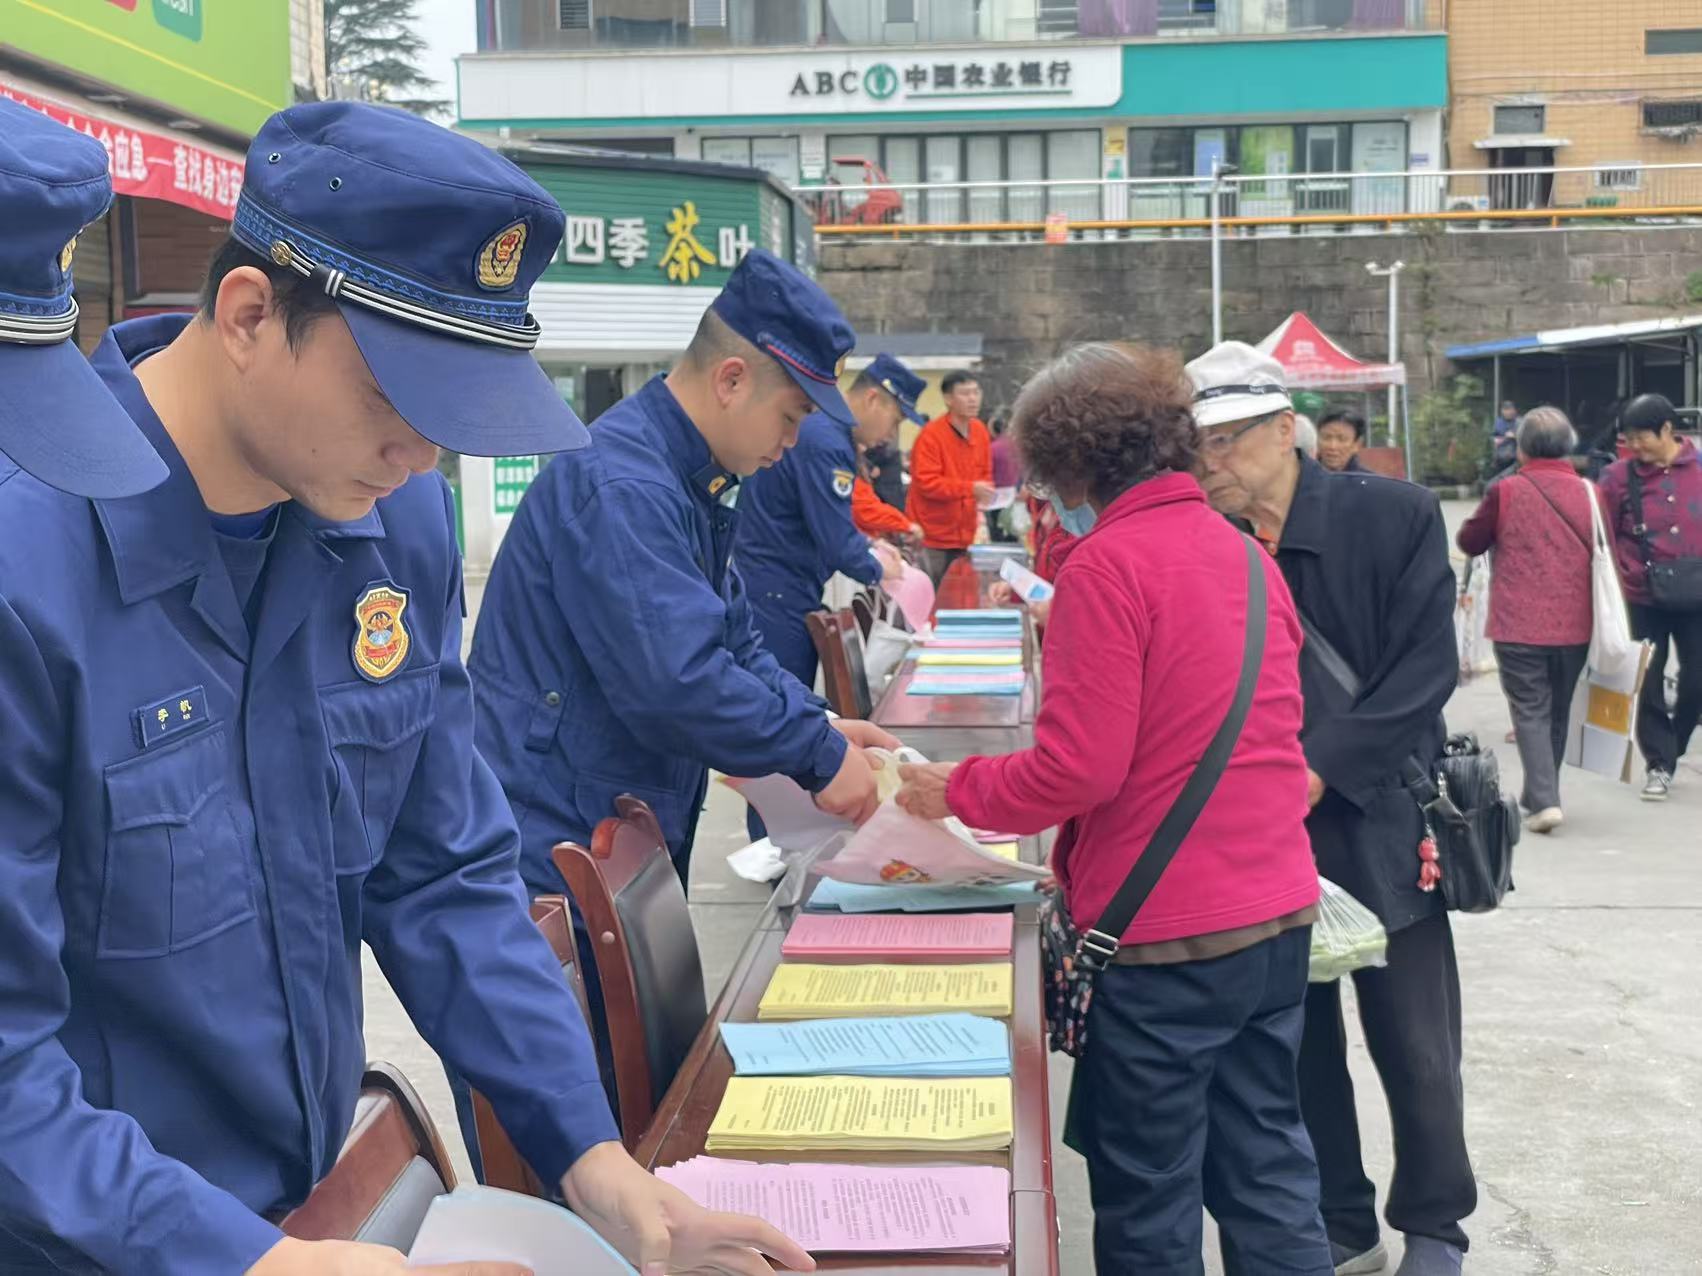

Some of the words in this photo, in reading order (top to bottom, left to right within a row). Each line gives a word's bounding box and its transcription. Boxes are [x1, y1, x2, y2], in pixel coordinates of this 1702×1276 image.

[790, 71, 859, 97] ABC
[904, 61, 1072, 91] 中国农业银行
[552, 201, 756, 284] 四季茶叶
